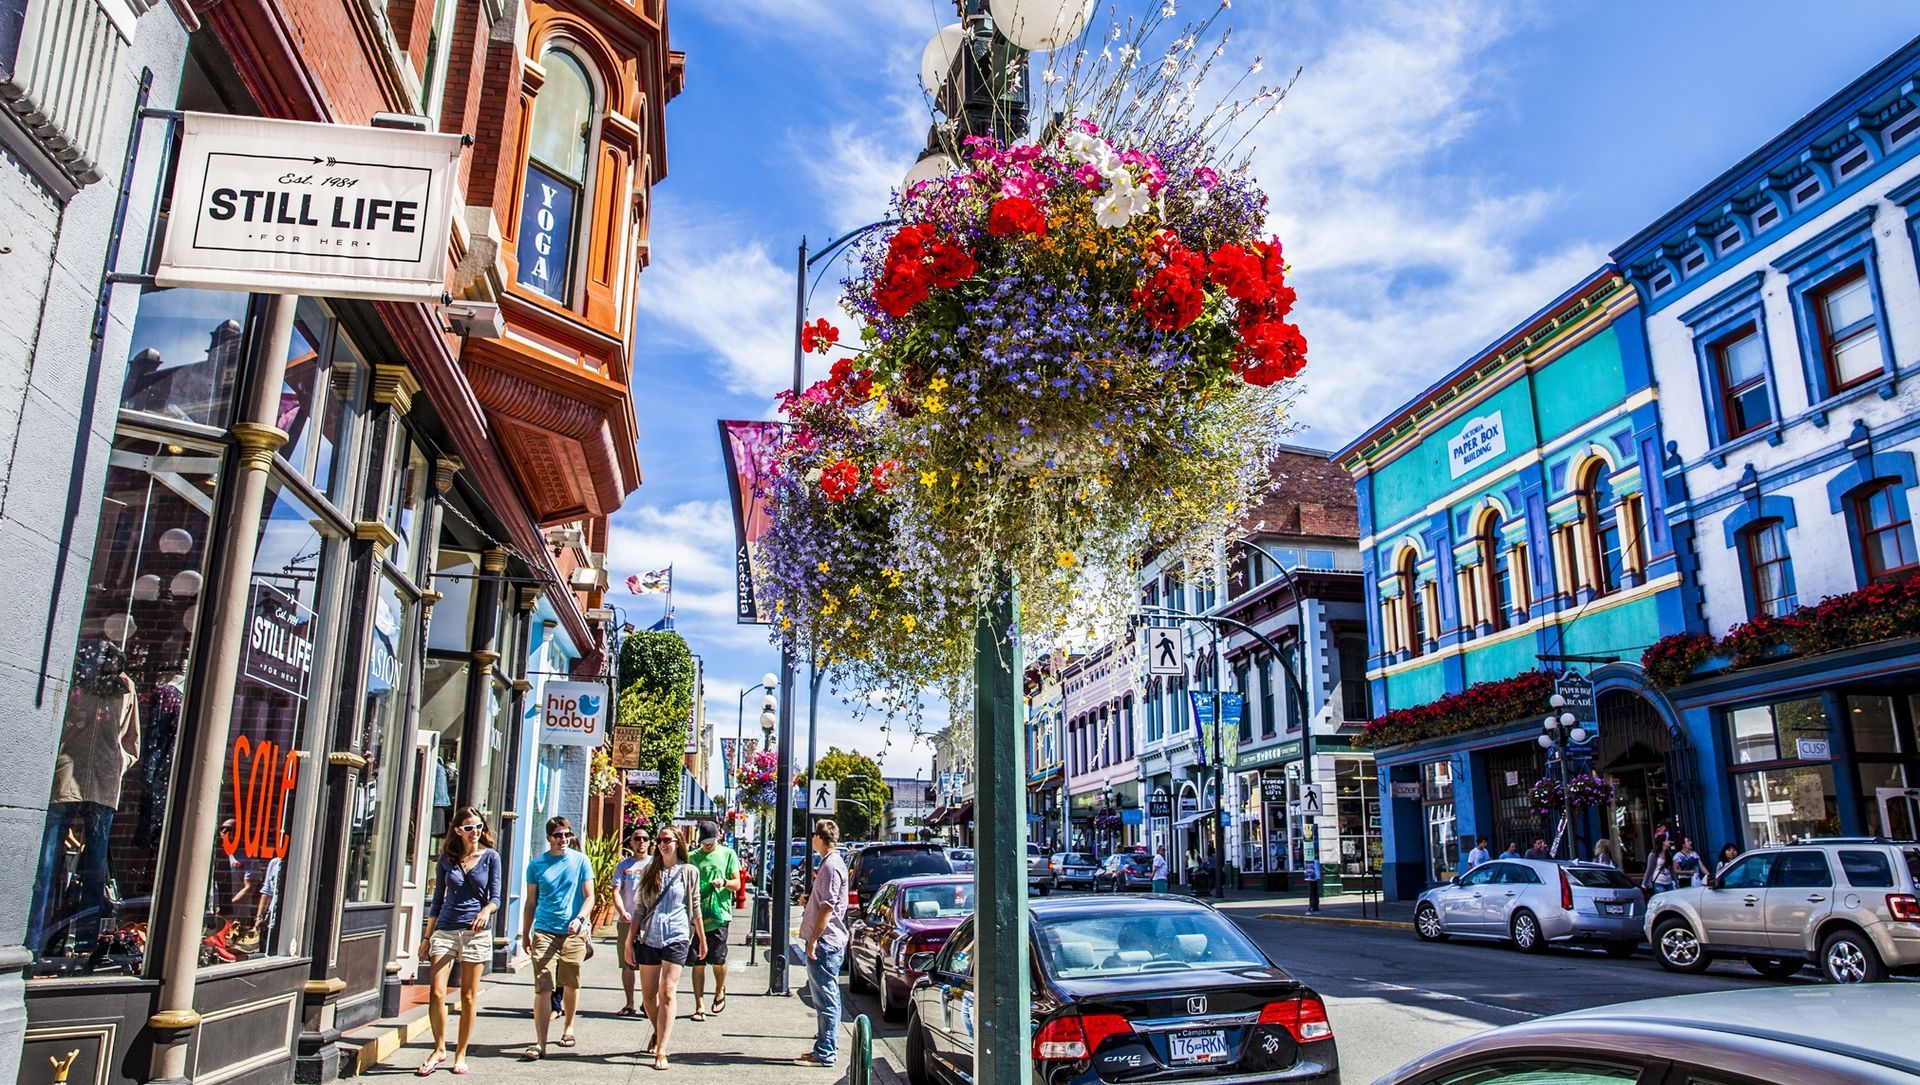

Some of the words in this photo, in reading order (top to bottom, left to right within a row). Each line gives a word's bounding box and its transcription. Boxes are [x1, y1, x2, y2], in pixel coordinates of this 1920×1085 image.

[278, 172, 313, 185] Est.
[321, 176, 359, 188] 1984
[208, 187, 318, 226] STILL
[331, 196, 418, 233] LIFE
[260, 234, 300, 243] FOR
[320, 238, 359, 248] HER
[531, 183, 558, 281] YOGA
[1453, 437, 1478, 459] PAPER
[1480, 424, 1499, 443] BOX
[1463, 424, 1484, 440] VICTORIA
[1463, 443, 1492, 465] BUILDING
[738, 545, 752, 614] Victoria
[252, 615, 285, 661] STILL
[286, 632, 313, 673] LIFE
[263, 664, 277, 676] FOR
[280, 673, 295, 683] HER
[1580, 687, 1592, 695] BOX
[547, 694, 577, 715] hip
[546, 710, 595, 733] baby
[1802, 742, 1826, 754] CUSP
[1182, 1029, 1211, 1037] Campus
[1172, 1039, 1195, 1056] 176
[1202, 1037, 1227, 1054] RKN
[1104, 1055, 1141, 1063] CIVIC
